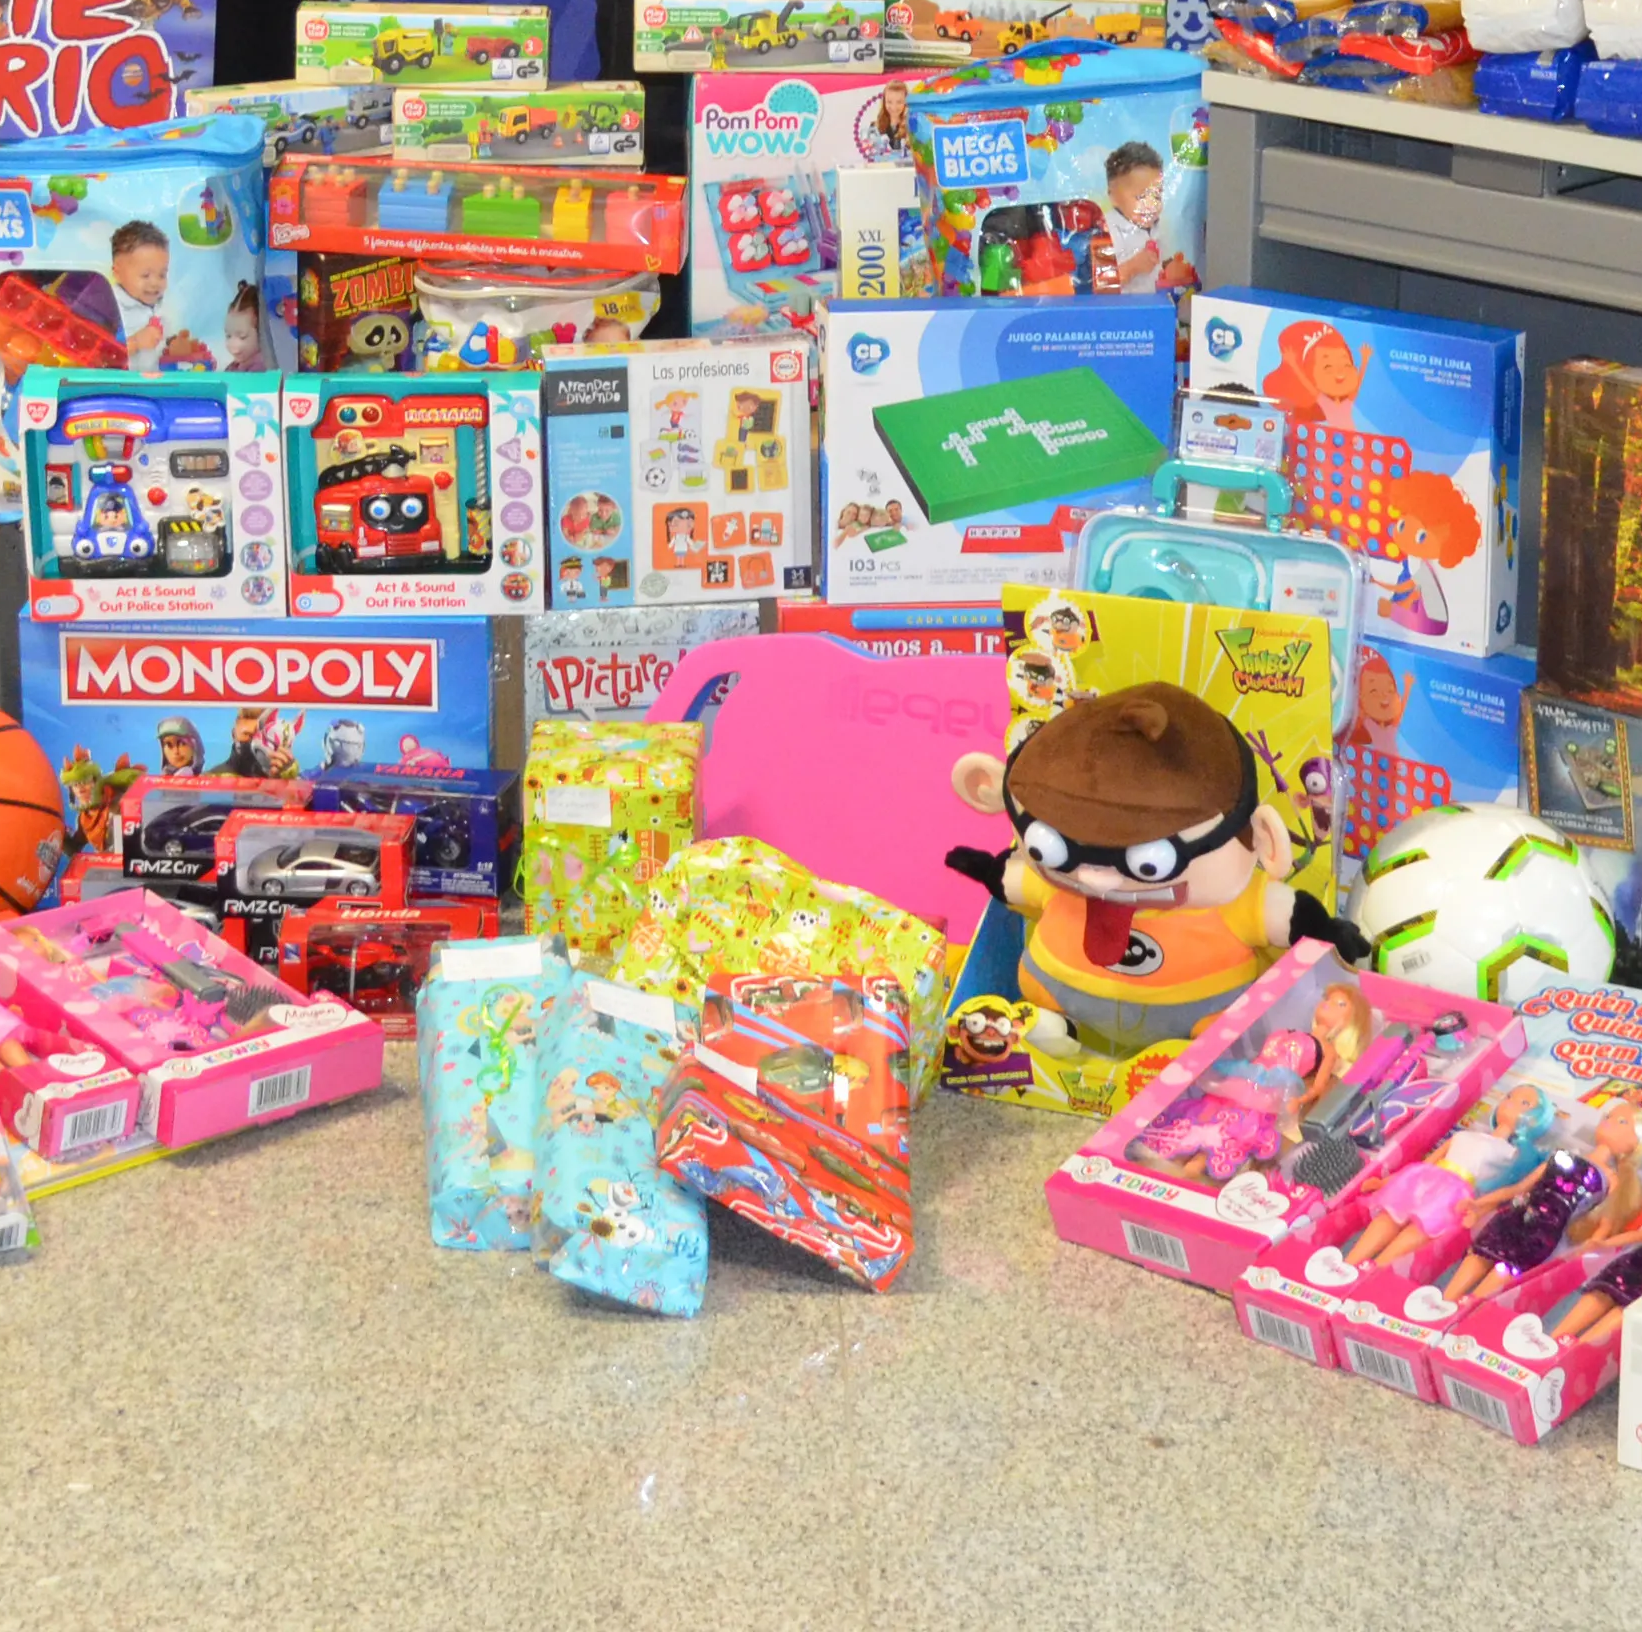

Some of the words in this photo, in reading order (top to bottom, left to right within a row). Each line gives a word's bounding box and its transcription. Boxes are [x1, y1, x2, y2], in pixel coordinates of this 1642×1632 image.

[705, 110, 751, 131] Pom
[754, 109, 799, 131] Pom
[705, 114, 817, 156] WOW!
[941, 135, 1012, 157] MEGA
[945, 153, 1020, 177] BLOKS
[857, 229, 886, 243] XXL
[602, 301, 619, 316] 18
[1007, 332, 1044, 345] JUEGO
[1045, 330, 1098, 344] PALABRAS
[1099, 329, 1155, 342] CRUZADAS
[653, 364, 674, 381] Las
[678, 361, 750, 382] profesiones
[115, 585, 142, 598] Act
[144, 585, 155, 598] &
[157, 584, 196, 598] Sound
[374, 580, 401, 593] Act
[403, 581, 413, 593] &
[417, 580, 456, 593] Sound
[98, 599, 124, 613] Out
[126, 599, 165, 613] Police
[167, 598, 214, 612] Station
[365, 595, 390, 609] Out
[392, 595, 417, 609] Fire
[418, 594, 467, 608] Station
[74, 643, 427, 701] MONOPOLY
[373, 763, 467, 779] YAMAHA
[341, 906, 422, 919] Honda
